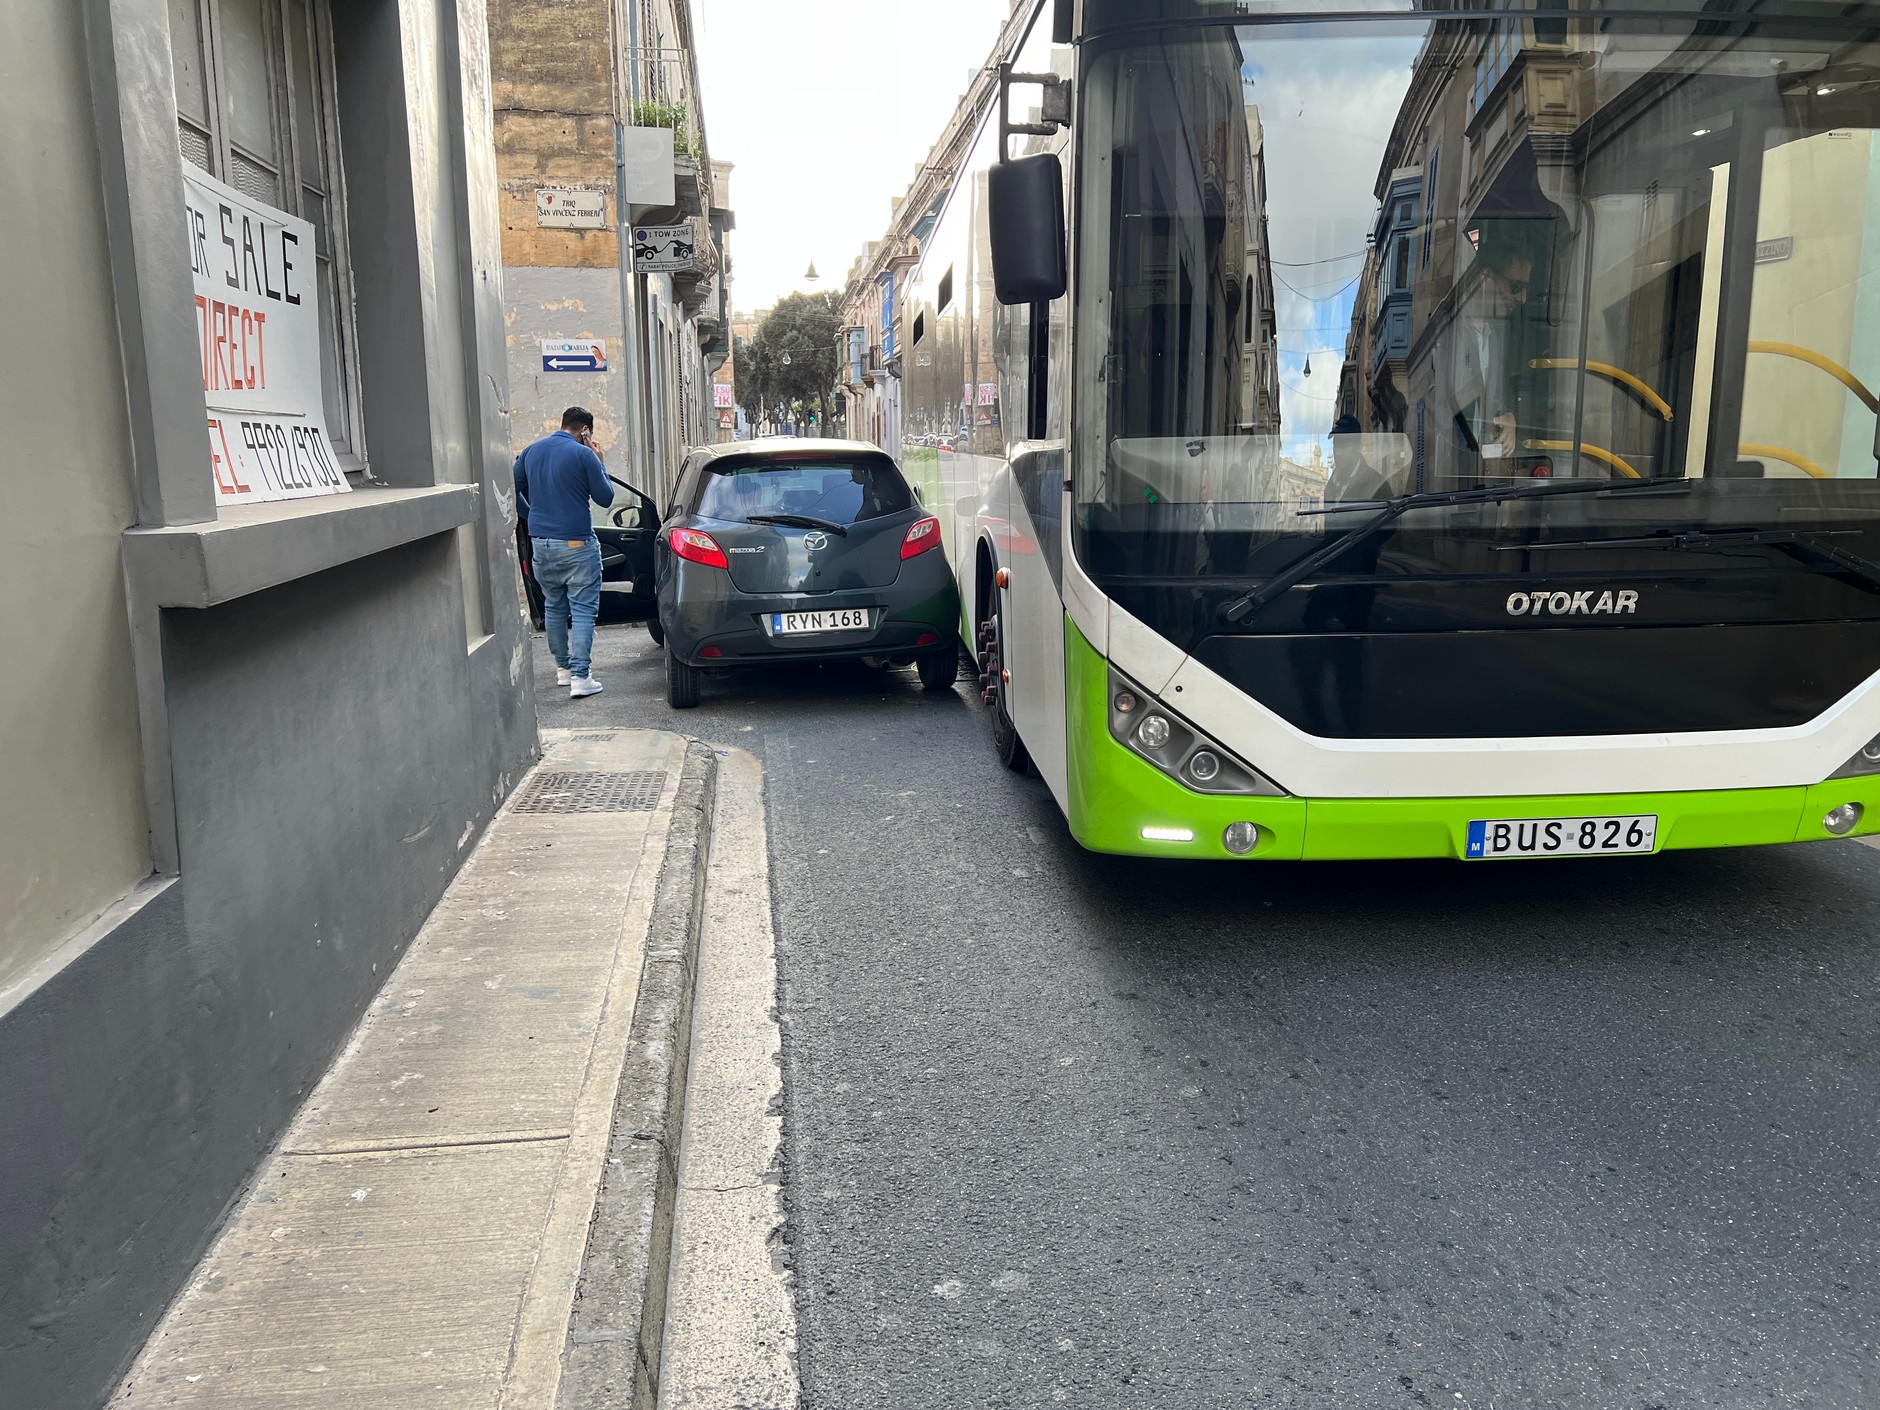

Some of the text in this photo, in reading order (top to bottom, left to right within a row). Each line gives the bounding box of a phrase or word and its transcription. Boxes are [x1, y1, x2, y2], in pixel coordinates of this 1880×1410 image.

[562, 200, 576, 208] TRIQ
[654, 230, 670, 238] TOW
[672, 228, 689, 237] ZONE
[186, 202, 300, 305] OR SALE
[195, 294, 265, 391] DIRECT
[207, 419, 251, 494] EL:
[1506, 590, 1639, 616] OTOKAR
[787, 613, 822, 630] RYN
[829, 611, 862, 627] 168
[1471, 819, 1644, 852] M BUS 826
